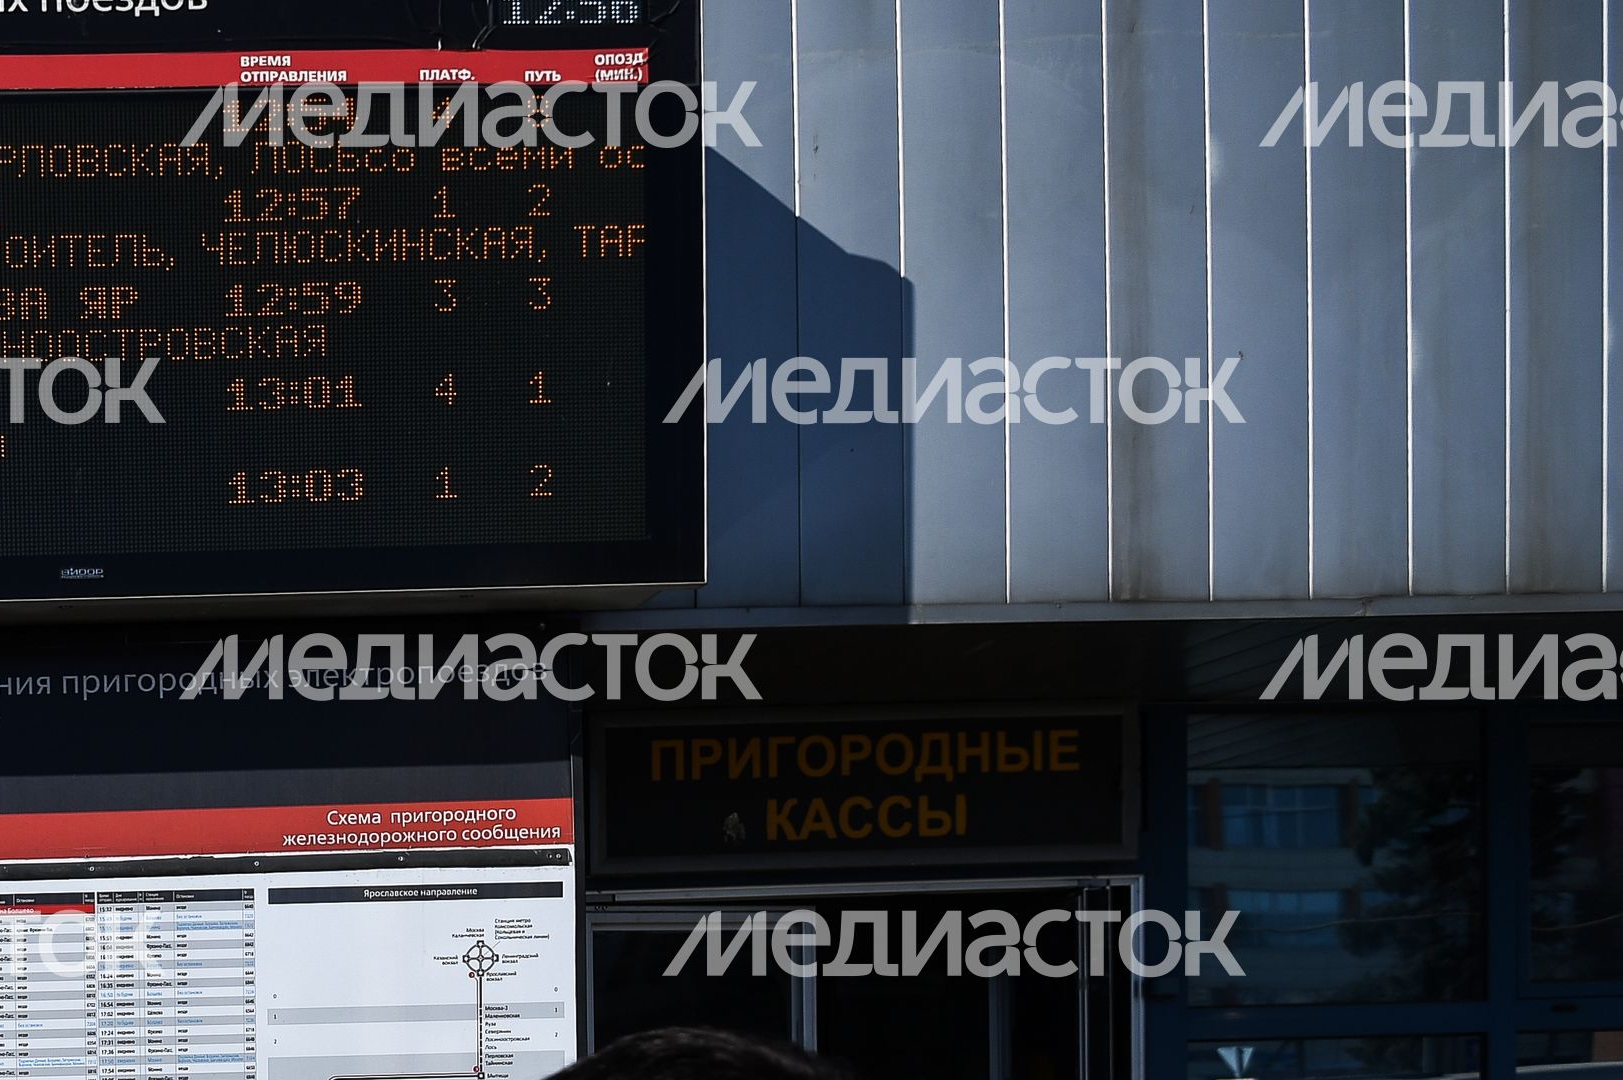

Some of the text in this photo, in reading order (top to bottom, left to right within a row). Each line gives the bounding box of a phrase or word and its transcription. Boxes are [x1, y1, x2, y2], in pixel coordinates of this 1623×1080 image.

[240, 55, 291, 68] ВРЕМЯ
[240, 69, 347, 83] ОТПРАВЛЕНИЯ
[419, 69, 475, 82] ПЛАТФ.
[525, 70, 562, 82] ПУТЬ
[442, 146, 572, 171] всеми
[224, 187, 360, 222] 12:57
[433, 186, 456, 218] 1
[528, 184, 550, 216] 2
[79, 286, 138, 319] ЯР
[225, 281, 361, 317] 12:59
[434, 279, 456, 312] 3
[529, 278, 551, 310] 3
[227, 375, 362, 411] 13:01
[435, 373, 457, 405] 4
[529, 371, 551, 404] 1
[228, 468, 363, 504] 13:03
[436, 467, 457, 499] 1
[530, 464, 552, 496] 2
[62, 668, 279, 700] пригородных
[287, 662, 549, 691] электропоездов
[651, 729, 1081, 783] ПРИГОРОДНЫЕ
[327, 805, 517, 827] Схема пригородного
[766, 793, 968, 841] КАССЫ
[282, 824, 561, 849] железнодорожного сообщения
[363, 887, 478, 899] Ярославское направление
